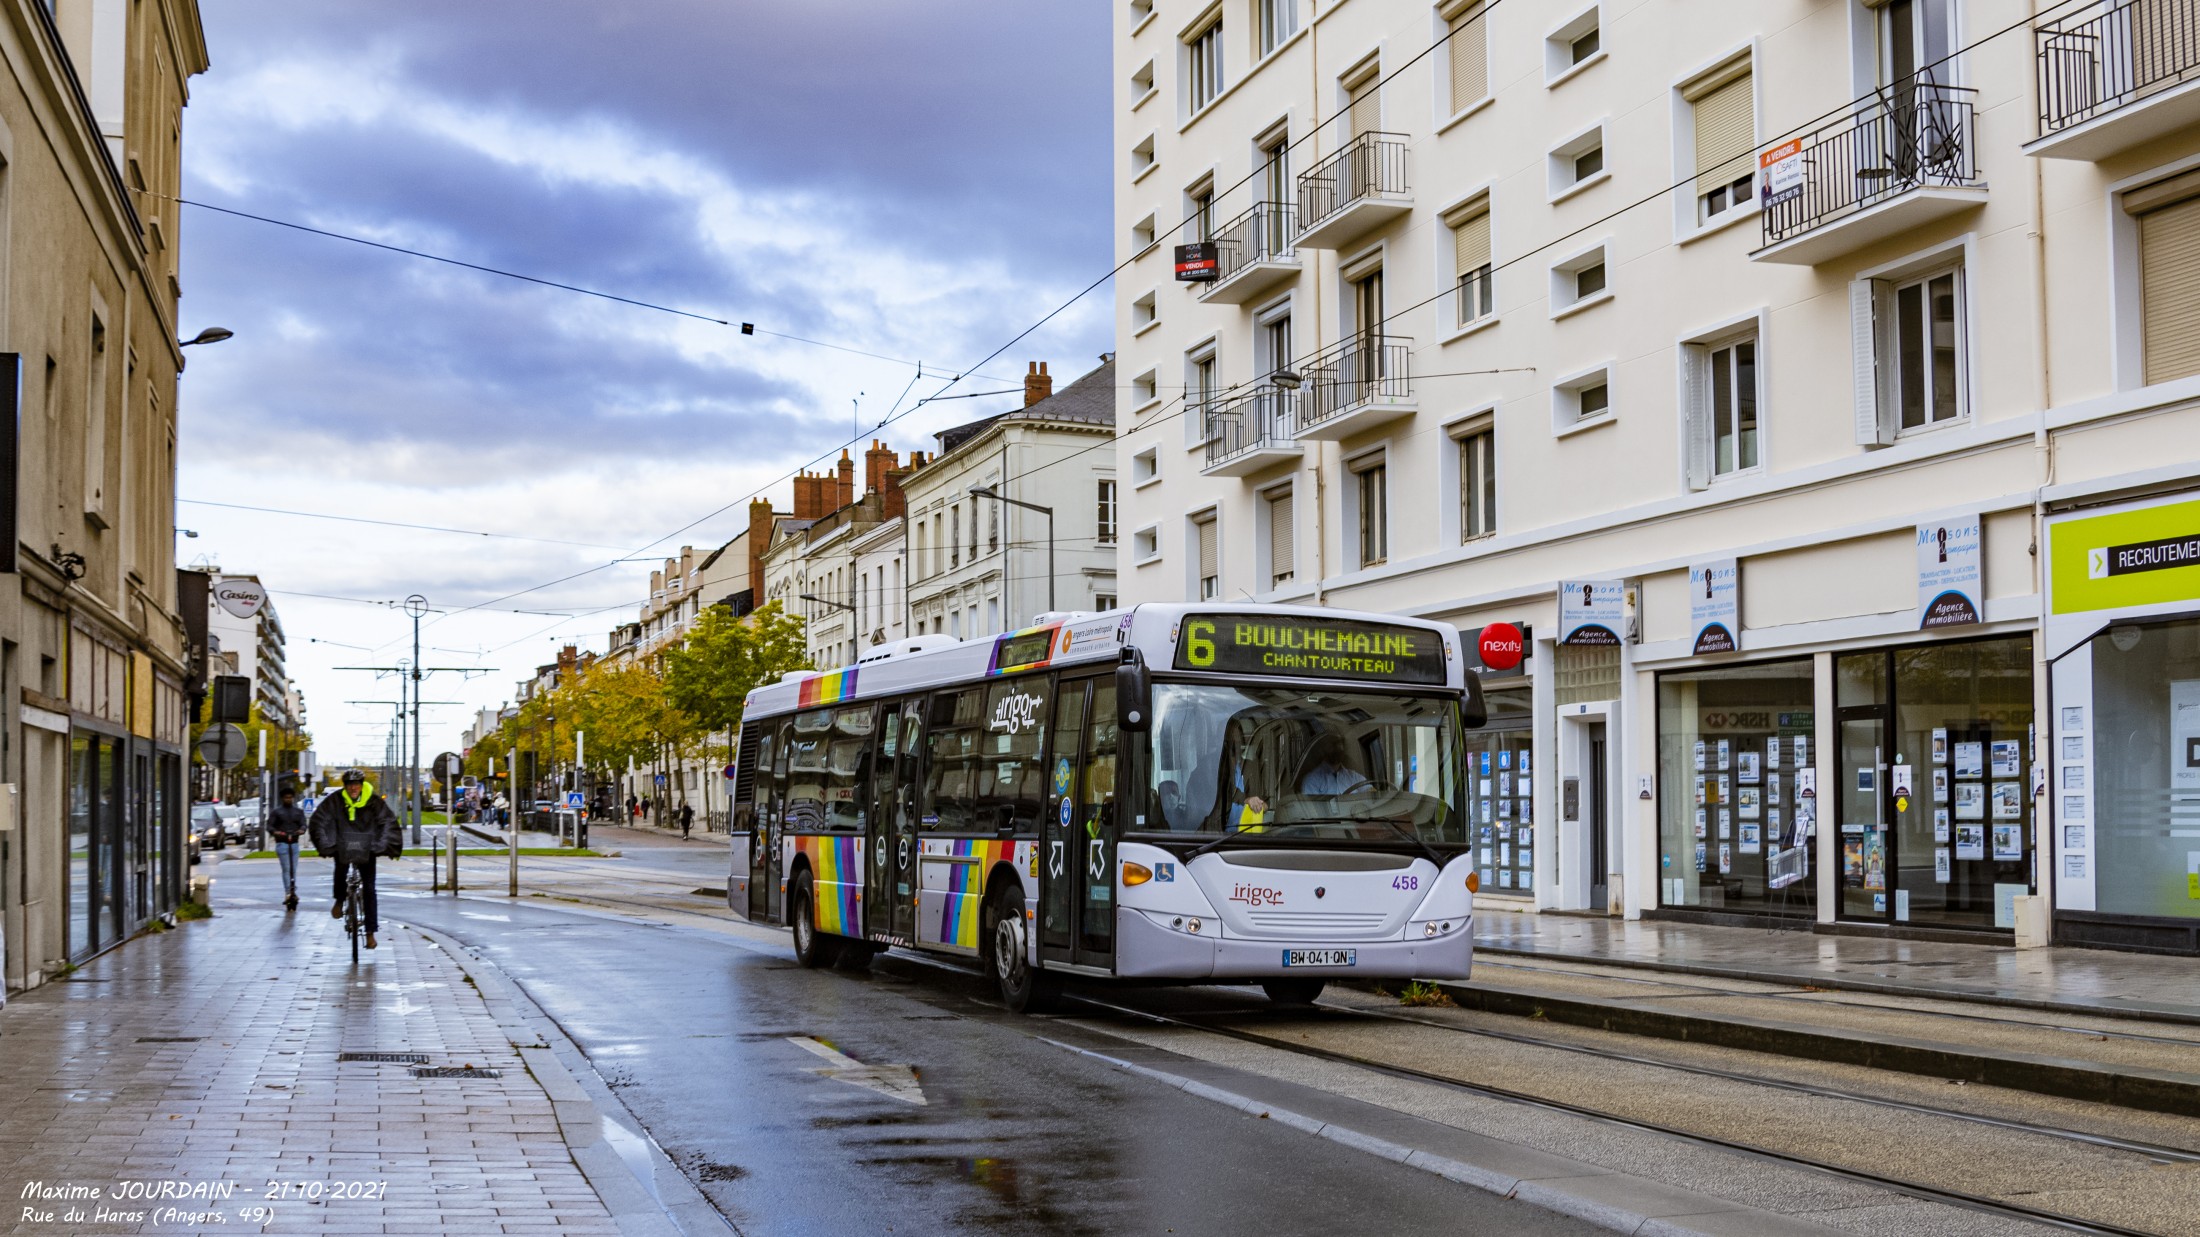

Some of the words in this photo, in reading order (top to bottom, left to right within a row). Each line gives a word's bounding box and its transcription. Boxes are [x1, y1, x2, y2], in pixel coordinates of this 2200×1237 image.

[1765, 154, 1771, 165] A
[1771, 143, 1795, 160] VENDRE
[1185, 262, 1204, 270] VENDU
[1918, 525, 1979, 546] Maisons
[1690, 568, 1736, 584] Maisons
[1954, 565, 1976, 575] LOCATION
[220, 589, 260, 601] Casino
[1564, 583, 1623, 594] Maisons
[1935, 602, 1964, 616] Agence
[1119, 614, 1133, 629] 458
[1926, 612, 1973, 626] immobilière
[1072, 630, 1086, 640] angers
[1579, 630, 1607, 638] Agence
[1703, 633, 1725, 644] Agence
[1187, 620, 1216, 667] 6
[1235, 622, 1417, 657] BOUCHEMAINE
[1483, 640, 1522, 653] nexity
[1697, 641, 1731, 653] immobilière
[1263, 652, 1395, 674] CHANTOURTEAU
[1391, 875, 1419, 891] 458
